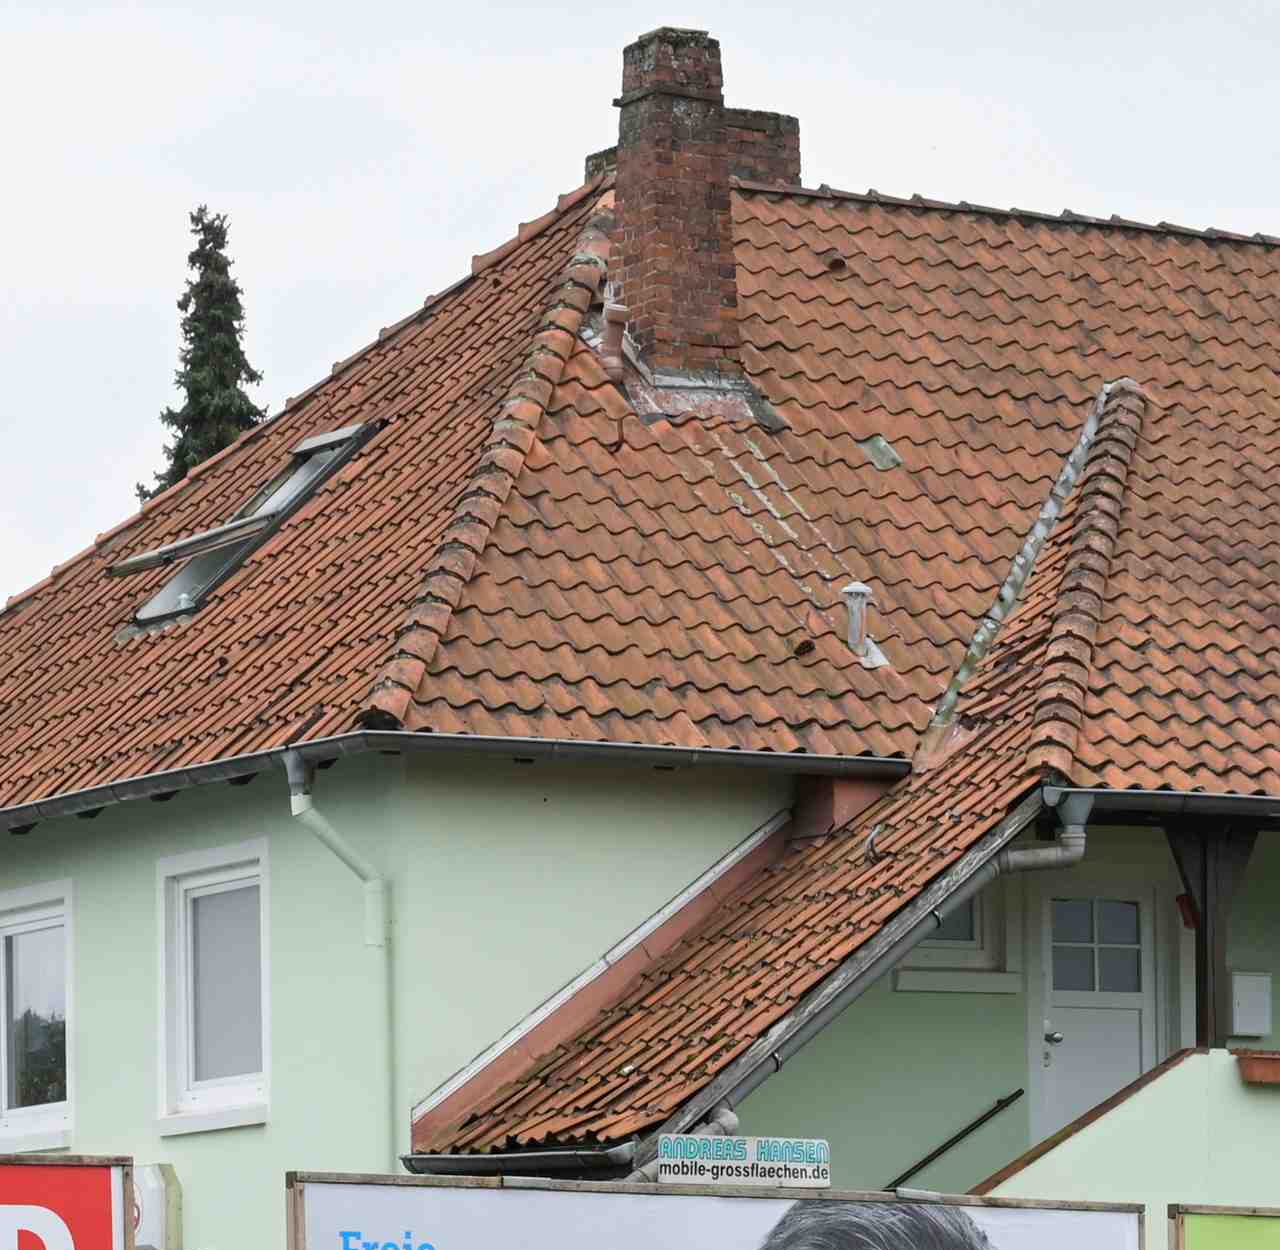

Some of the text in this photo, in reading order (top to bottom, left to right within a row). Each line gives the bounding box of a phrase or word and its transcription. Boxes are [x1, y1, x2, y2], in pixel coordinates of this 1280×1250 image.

[659, 1136, 829, 1163] ANDREAS HANSEN
[659, 1160, 828, 1180] mobile-grossflaechen.de
